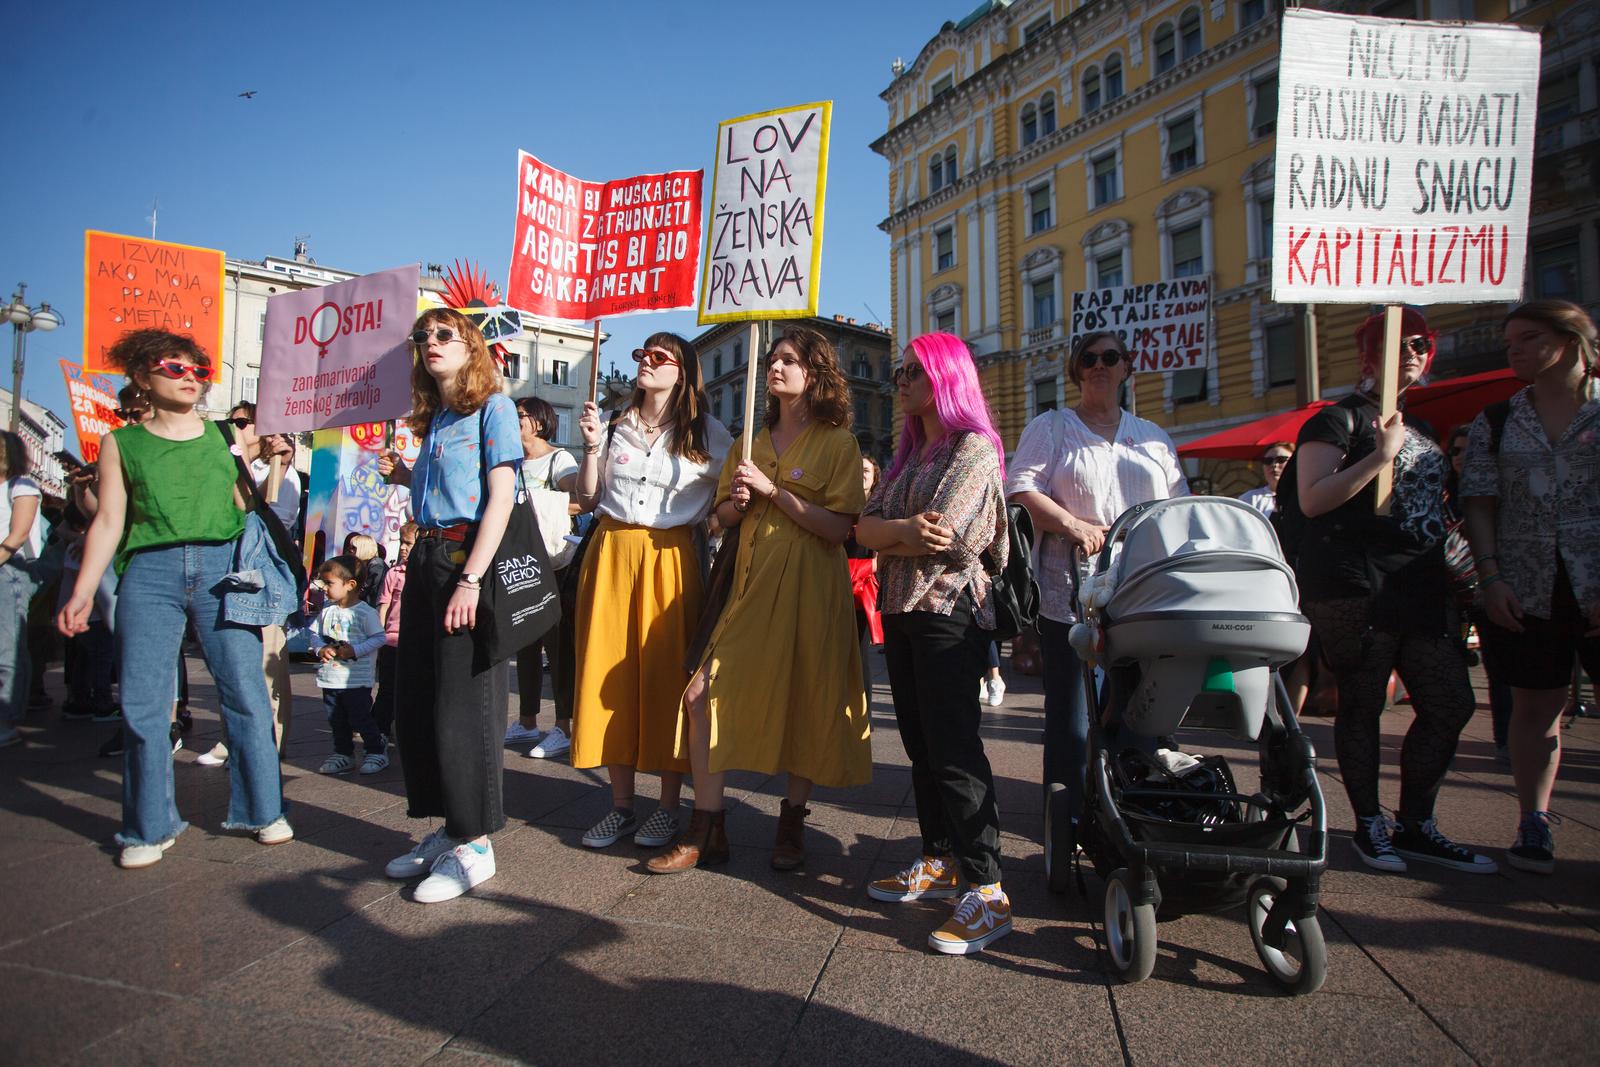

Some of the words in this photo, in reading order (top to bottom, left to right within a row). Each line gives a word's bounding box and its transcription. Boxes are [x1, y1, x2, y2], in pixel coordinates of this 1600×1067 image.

[727, 113, 816, 164] LOV
[525, 163, 576, 208] KADA
[584, 190, 600, 211] BI
[741, 158, 792, 202] NA
[1289, 153, 1390, 211] RADNU
[1412, 157, 1516, 215] SNAGU
[523, 191, 571, 235] MOGLI
[582, 201, 690, 239] ZATRUDNJETI
[713, 197, 813, 260] ŽENSKA
[122, 242, 185, 269] IZVINI
[521, 224, 618, 274] ABORTUS
[627, 235, 646, 267] BI
[655, 231, 688, 263] BIO
[1287, 224, 1508, 287] KAPITALIZMU
[98, 261, 137, 282] AKO
[155, 268, 201, 290] MOJA
[531, 267, 666, 303] SAKRAMENT
[708, 255, 803, 310] PRAVA
[1073, 289, 1112, 312] KAD
[1123, 280, 1208, 305] NEPRAVDA
[109, 307, 193, 328] SMETAJU
[294, 299, 383, 358] DOSTA!
[1073, 303, 1160, 333] POSTAJE
[1165, 301, 1206, 318] ZAKON
[1133, 322, 1205, 348] POSTAJE
[292, 361, 376, 392] zanemarivanja
[73, 396, 94, 414] ZA
[284, 393, 332, 416] ženskog
[335, 385, 380, 410] zdravlja
[81, 440, 99, 463] VR
[1212, 623, 1253, 631] MAXI-COSI
